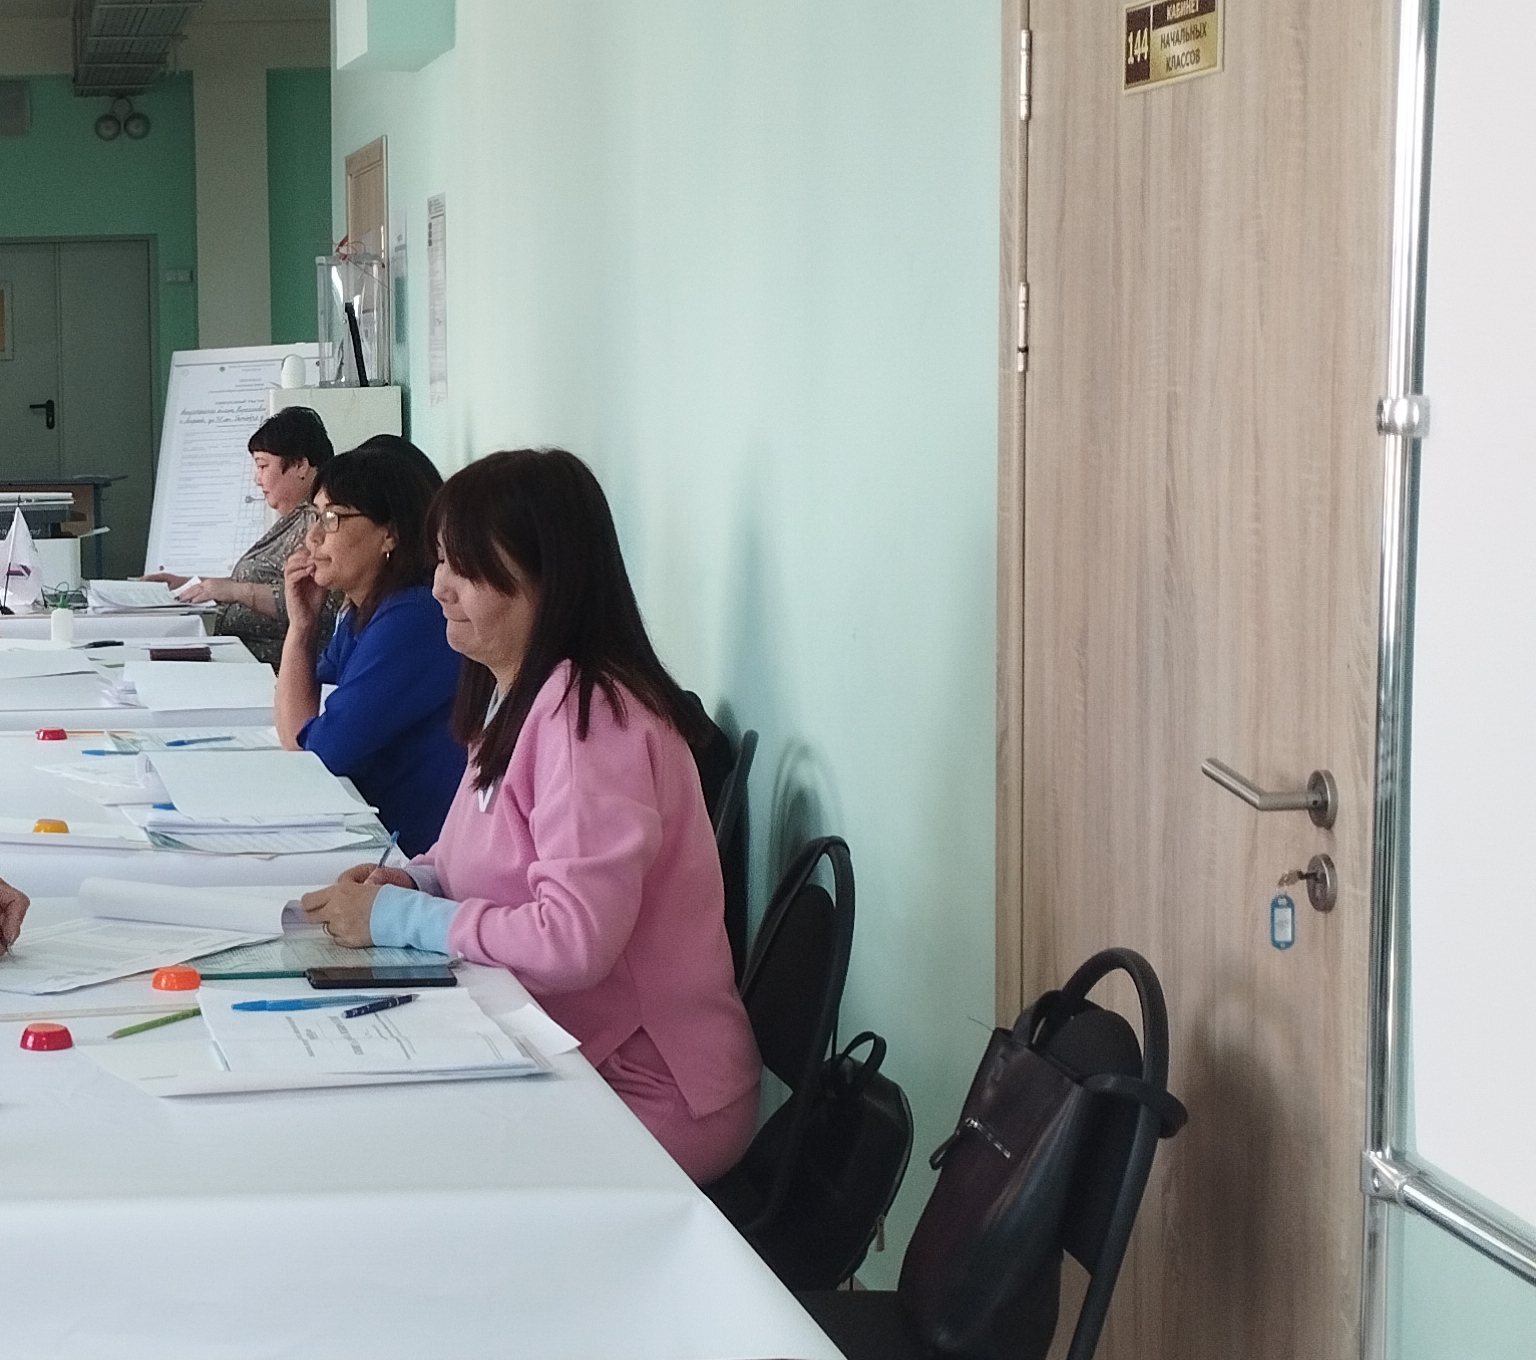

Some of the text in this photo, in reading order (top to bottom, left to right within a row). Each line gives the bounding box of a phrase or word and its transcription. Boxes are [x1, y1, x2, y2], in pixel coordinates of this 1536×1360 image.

[1127, 27, 1149, 65] 144
[1160, 22, 1208, 50] НАЧАЛЬНЫХ
[1165, 48, 1202, 72] КЛАССОВ
